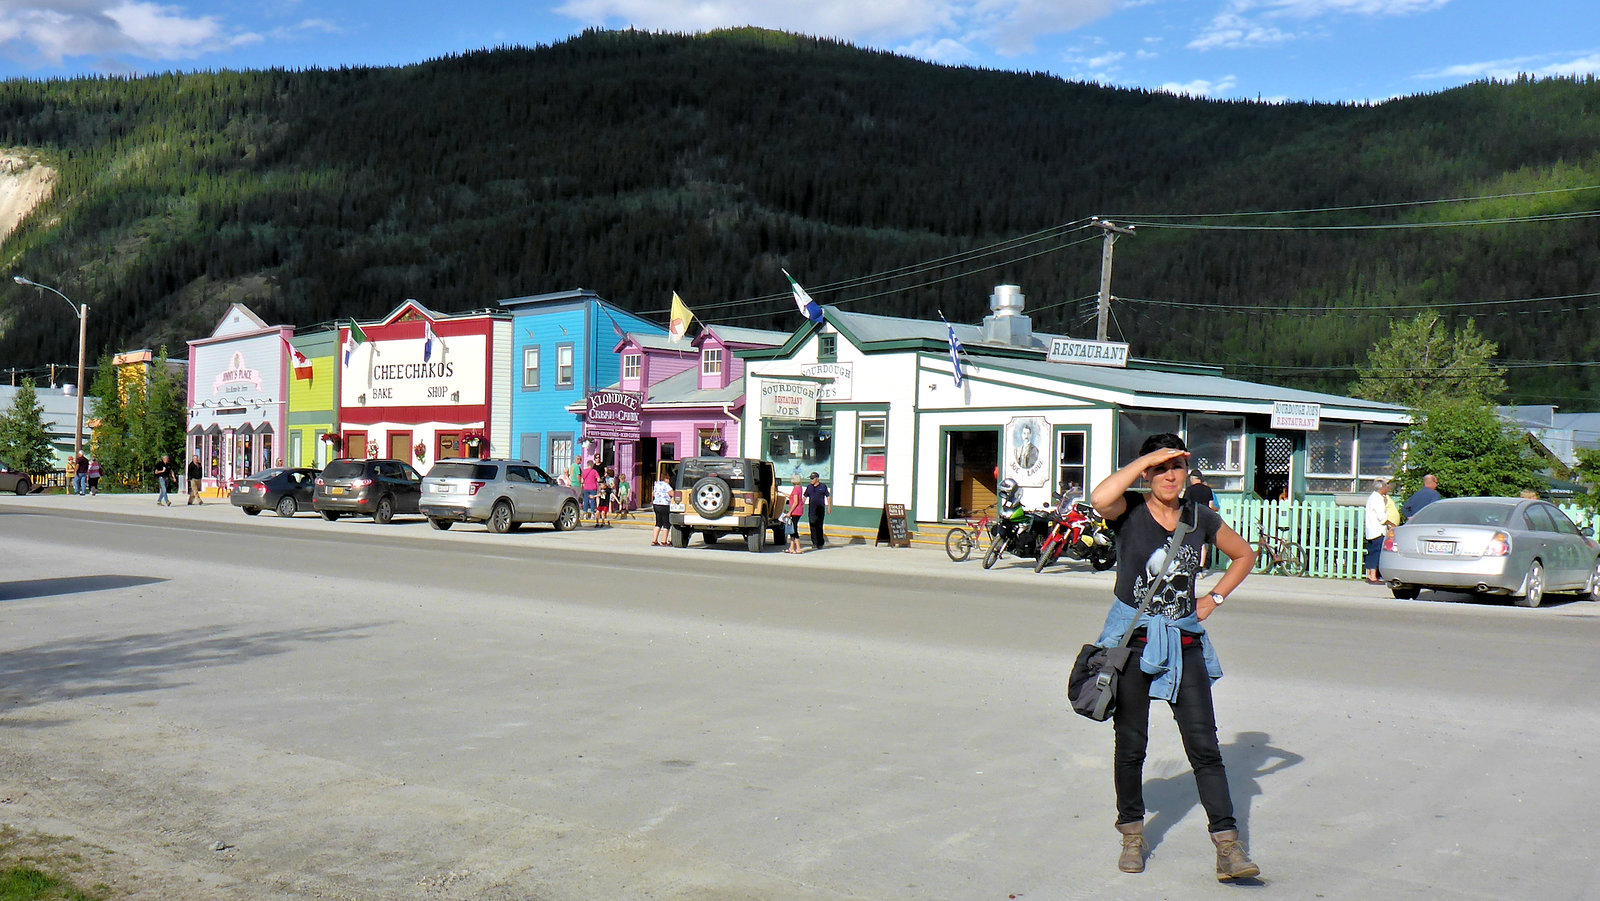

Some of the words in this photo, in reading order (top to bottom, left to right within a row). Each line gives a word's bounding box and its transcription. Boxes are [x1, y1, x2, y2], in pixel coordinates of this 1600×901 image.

[1052, 342, 1126, 360] RESTAURANT
[373, 362, 454, 380] CHEECHAKOS
[372, 388, 393, 399] BAKE
[427, 386, 448, 398] SHOP
[762, 384, 815, 399] SOURDOUGH
[590, 393, 638, 410] KLONDYKE
[774, 395, 803, 405] RESTAURANT
[588, 408, 615, 420] CREAM
[776, 405, 800, 415] JOE'S
[1276, 403, 1305, 415] SOURDOUGH
[1276, 416, 1315, 427] RESTAURANT
[1009, 461, 1021, 474] JOE
